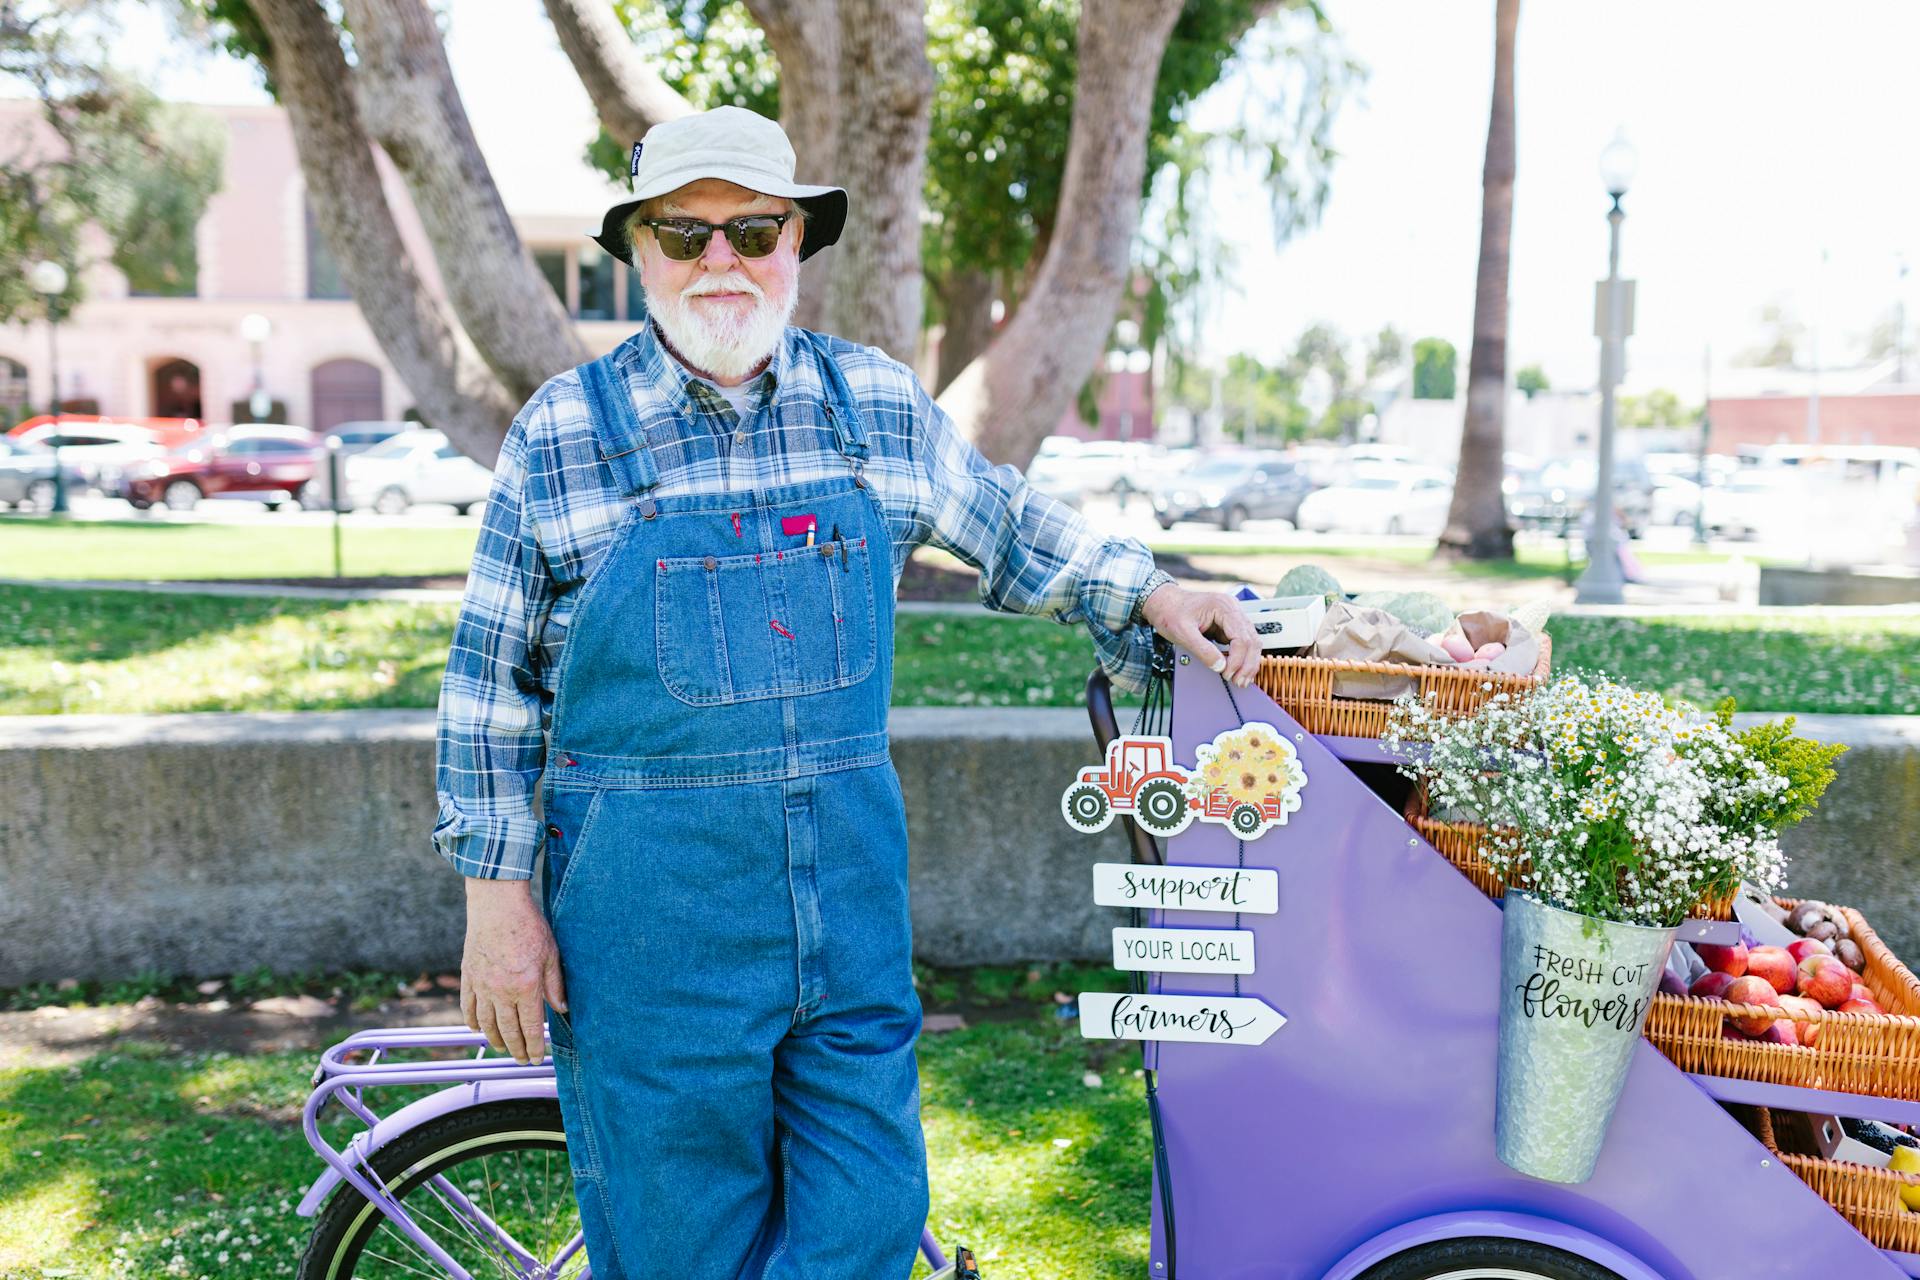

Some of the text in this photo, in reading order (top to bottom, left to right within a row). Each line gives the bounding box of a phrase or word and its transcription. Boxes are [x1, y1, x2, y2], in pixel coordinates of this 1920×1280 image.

[1118, 871, 1251, 906] support
[1124, 939, 1241, 962] YOUR LOCAL
[1111, 995, 1257, 1040] farmers
[1515, 973, 1649, 1032] flowers
